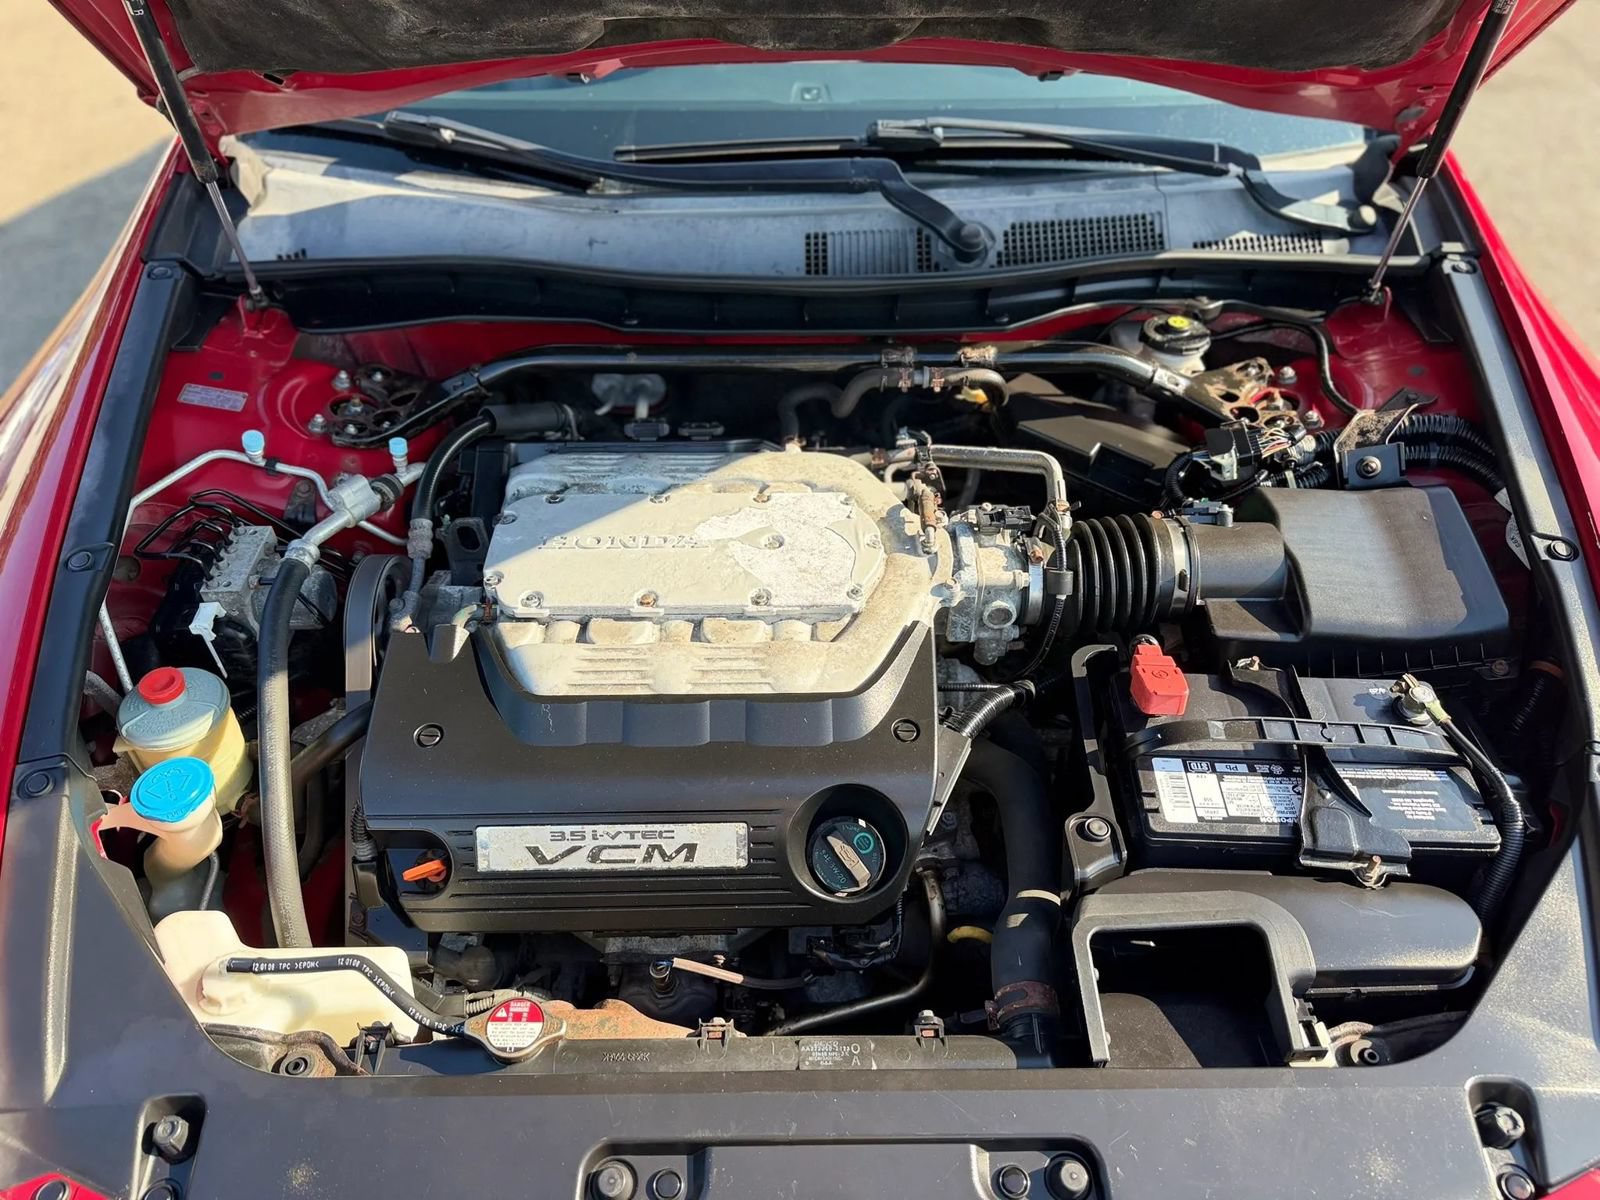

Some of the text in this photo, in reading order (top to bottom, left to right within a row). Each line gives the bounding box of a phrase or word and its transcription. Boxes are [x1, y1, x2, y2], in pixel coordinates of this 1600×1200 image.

[537, 535, 710, 550] HONDA
[1225, 764, 1238, 772] Pb
[549, 829, 675, 842] 3.5 i-VTEC
[525, 843, 698, 865] VCM
[279, 962, 291, 970] TPC
[362, 964, 373, 977] TPC
